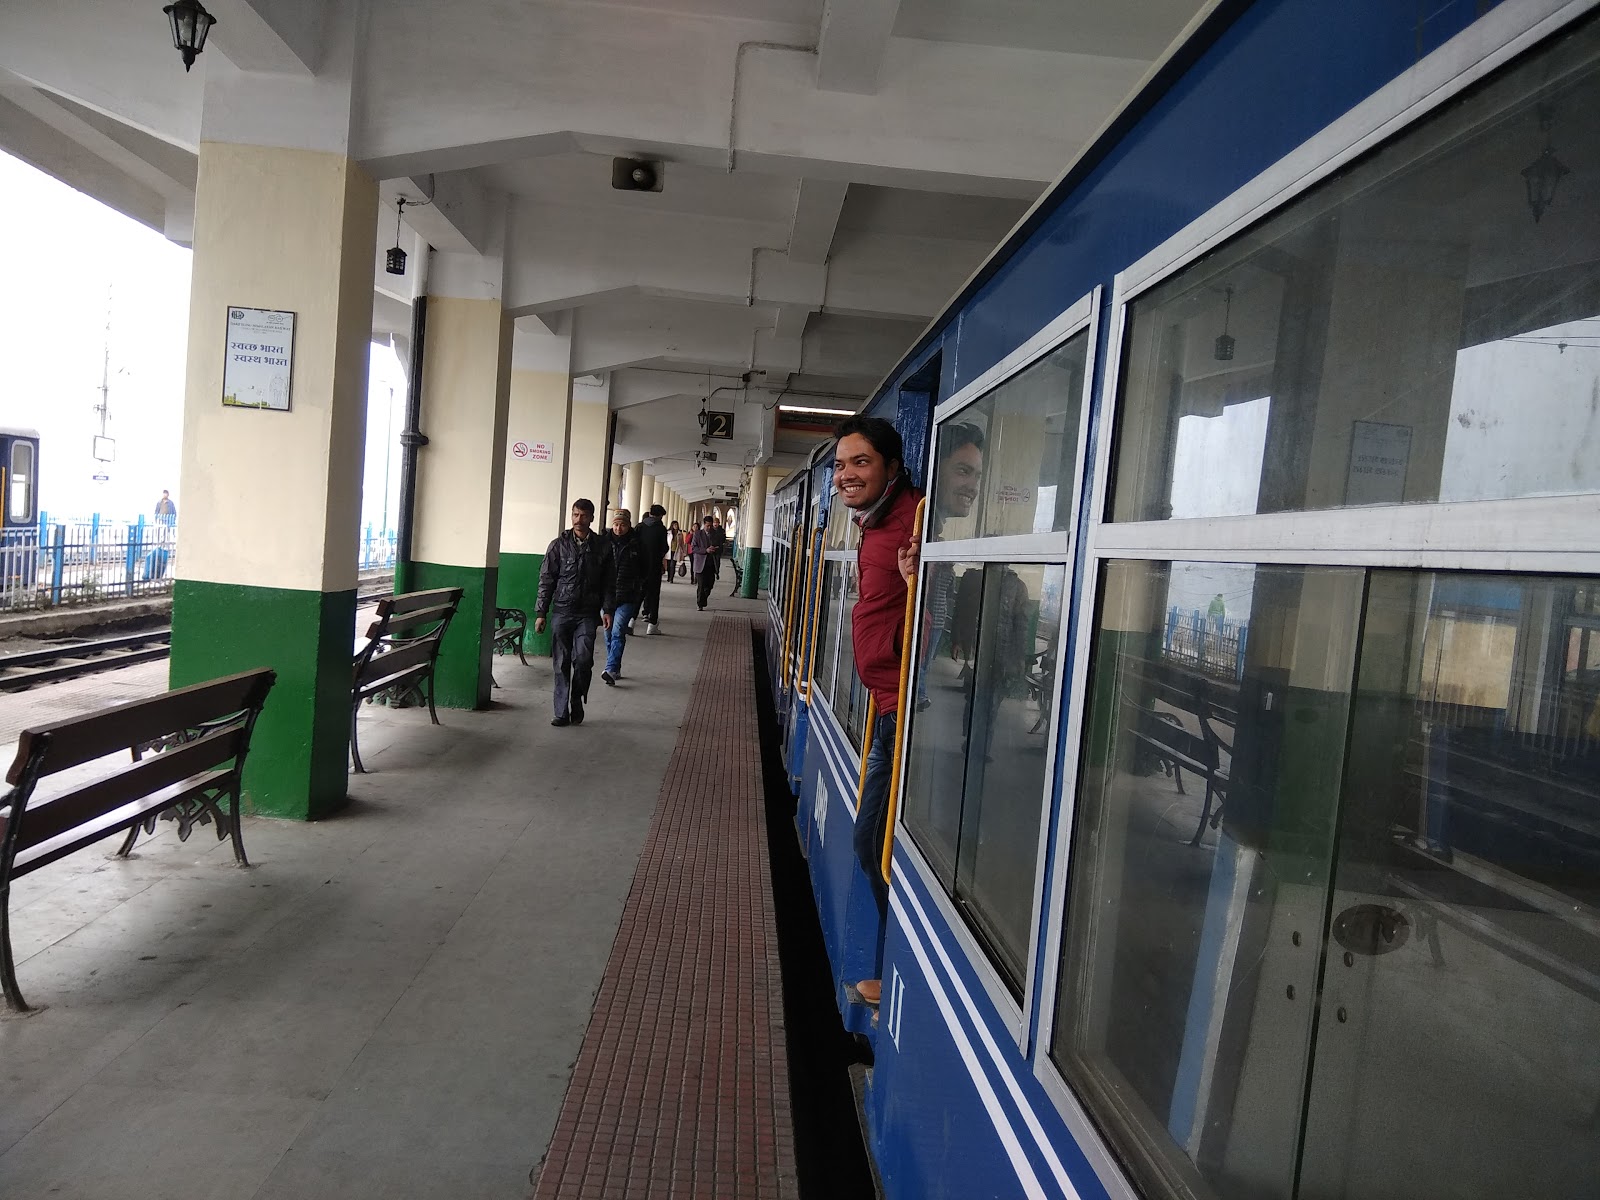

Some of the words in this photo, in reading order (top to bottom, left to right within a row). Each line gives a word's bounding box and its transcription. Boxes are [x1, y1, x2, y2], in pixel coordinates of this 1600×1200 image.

[230, 342, 258, 351] स्वच्छ
[260, 344, 284, 354] भारत
[234, 354, 262, 364] स्वस्थ
[264, 357, 288, 366] भारत
[712, 415, 726, 436] 2
